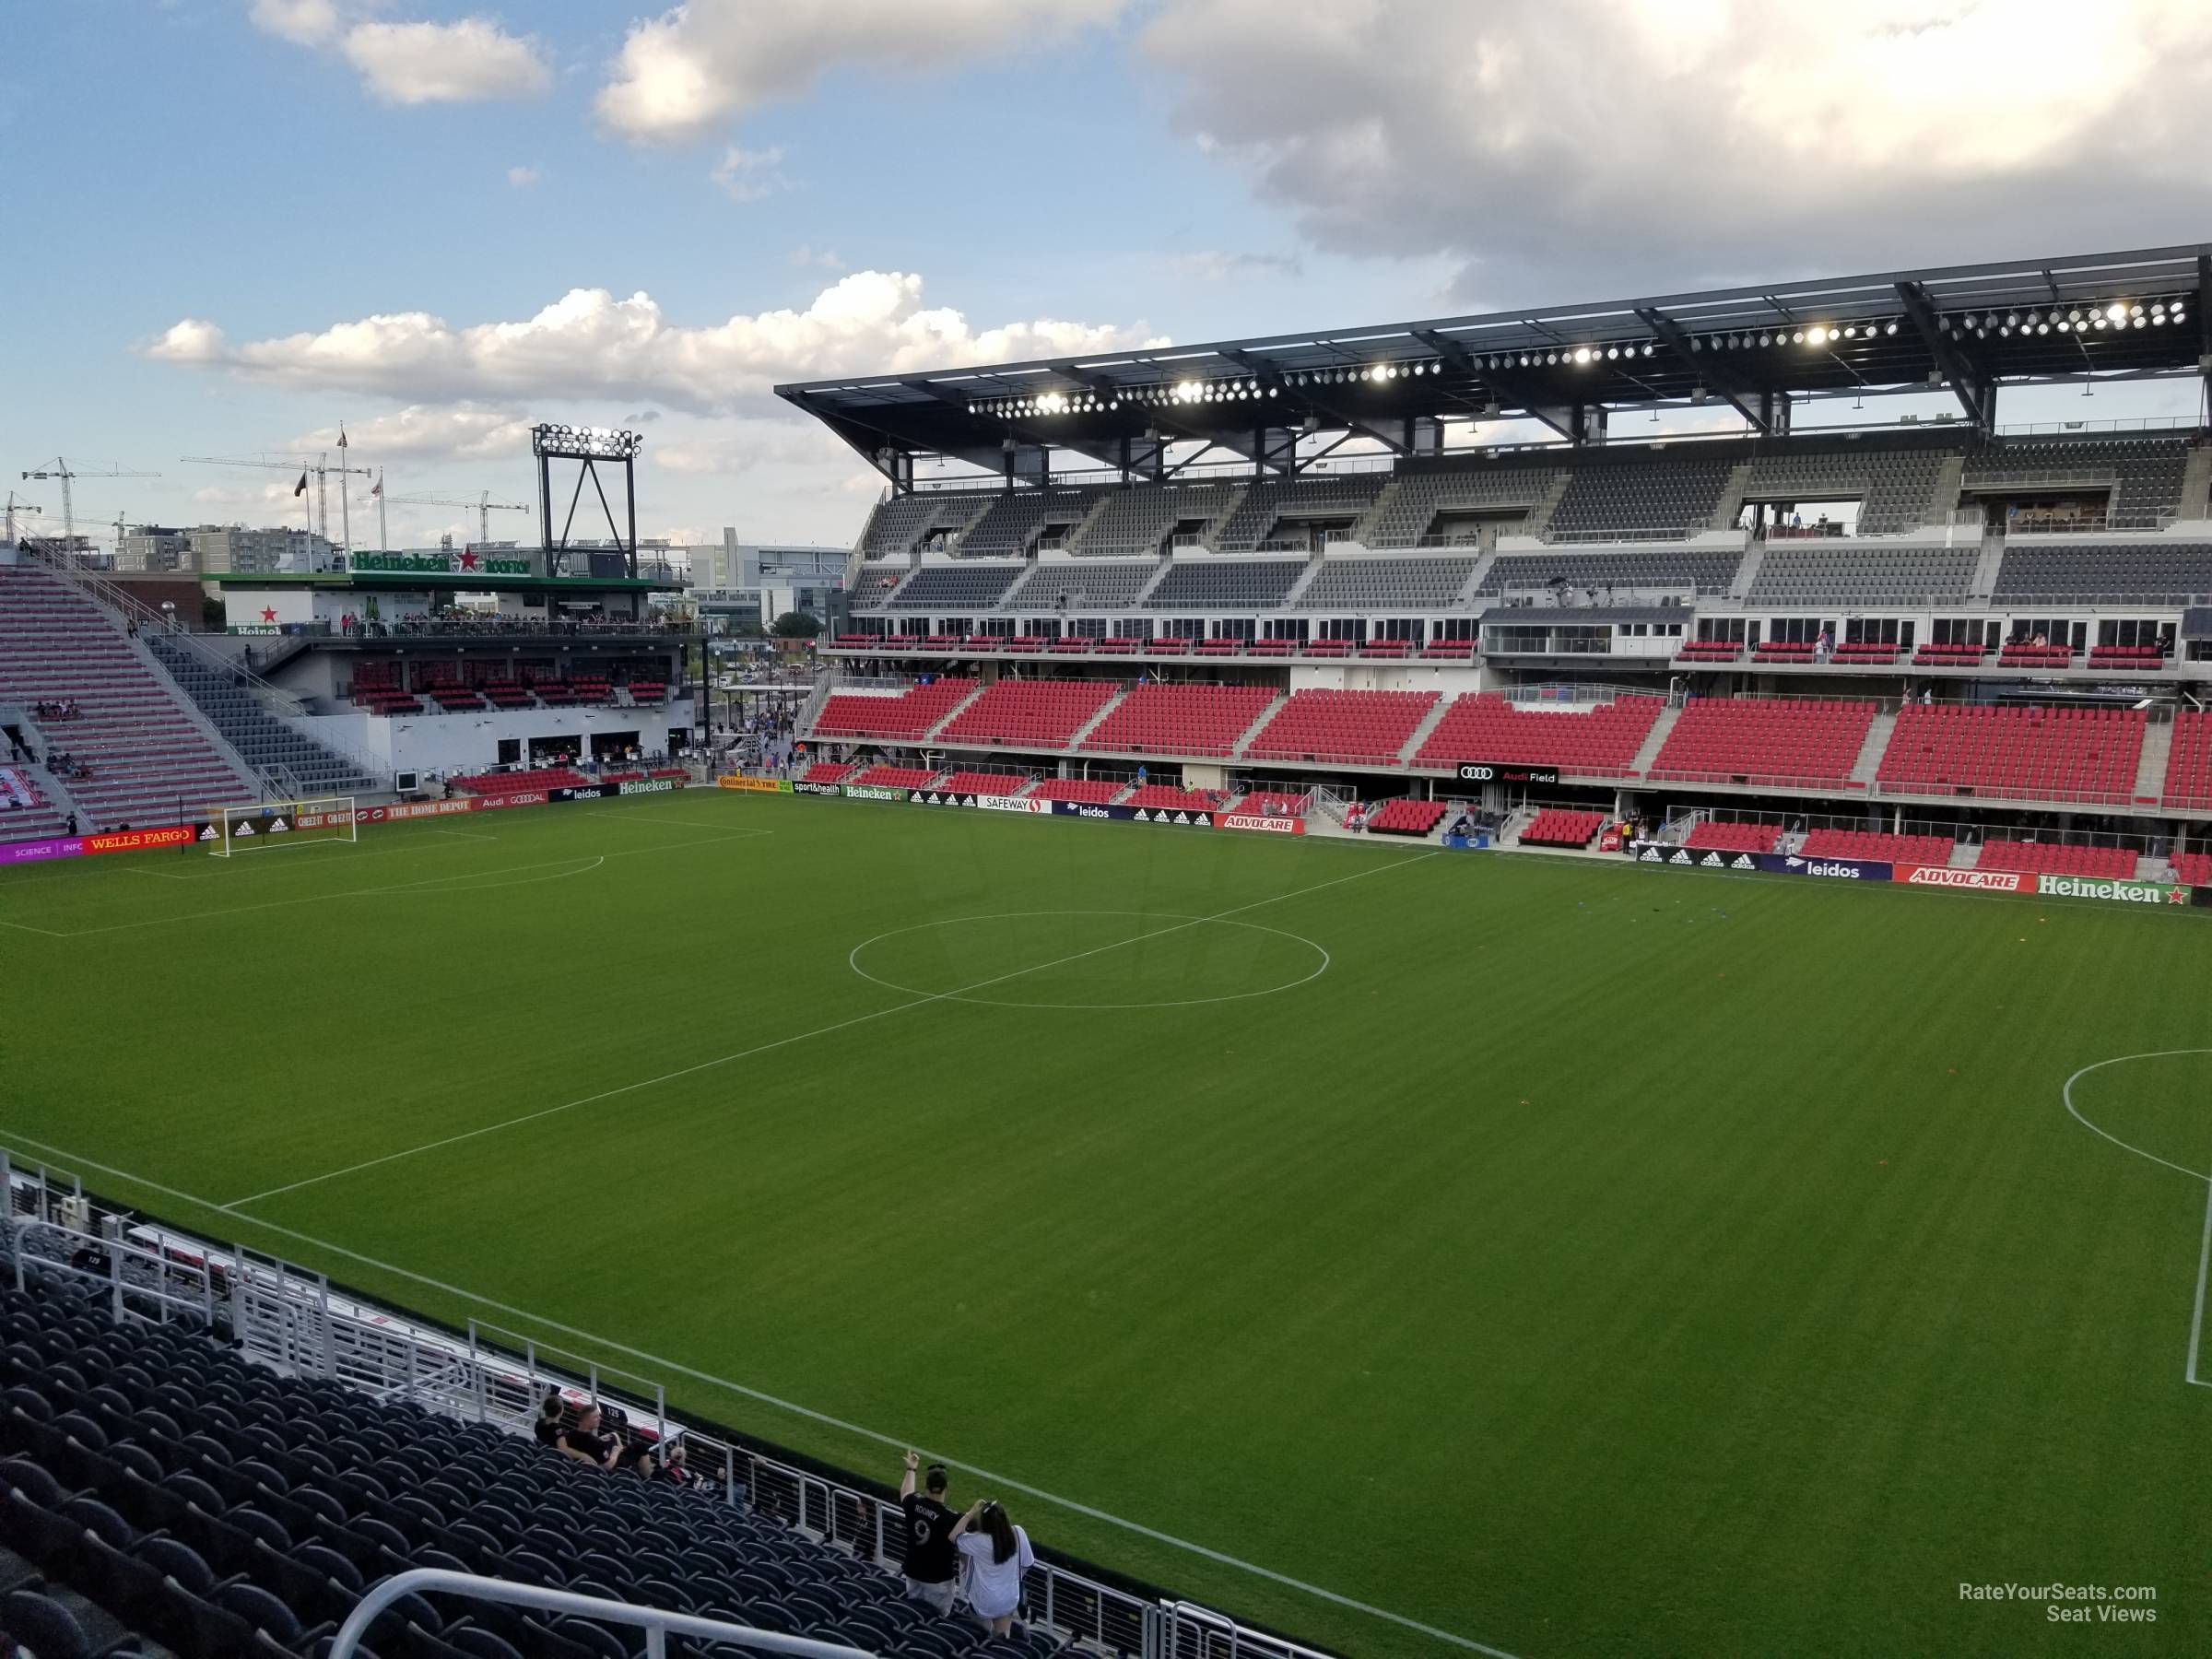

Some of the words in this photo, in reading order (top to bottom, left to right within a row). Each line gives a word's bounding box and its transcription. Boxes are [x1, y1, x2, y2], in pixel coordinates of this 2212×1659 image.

[353, 552, 451, 572] Heineken
[1503, 771, 1528, 781] Audi
[1530, 773, 1555, 782] Field
[619, 780, 673, 795] Heineken
[794, 782, 840, 794] sport&health
[846, 786, 892, 801] Heineken
[574, 788, 601, 800] leidos
[482, 797, 503, 807] Audi
[986, 797, 1029, 810] SAFEWAY
[389, 806, 408, 818] THE
[411, 803, 438, 815] HOME
[440, 800, 470, 813] DEPOT
[1079, 806, 1110, 818] leidos
[1225, 815, 1293, 831] ADVOCARE
[235, 829, 254, 837] adidas
[91, 835, 141, 850] WELLS
[144, 830, 190, 844] FARGO
[15, 846, 53, 857] SCIENCE
[1640, 854, 1663, 863] adidas
[1668, 857, 1692, 866] adidas
[1700, 859, 1724, 868] adidas
[1731, 862, 1755, 870] adidas
[1807, 861, 1860, 878] leidos
[1909, 867, 2020, 891] ADVOCARE
[2038, 875, 2161, 904] Heineken
[607, 1407, 619, 1418] 125
[914, 1504, 940, 1521] ROONEY
[914, 1519, 931, 1546] 9
